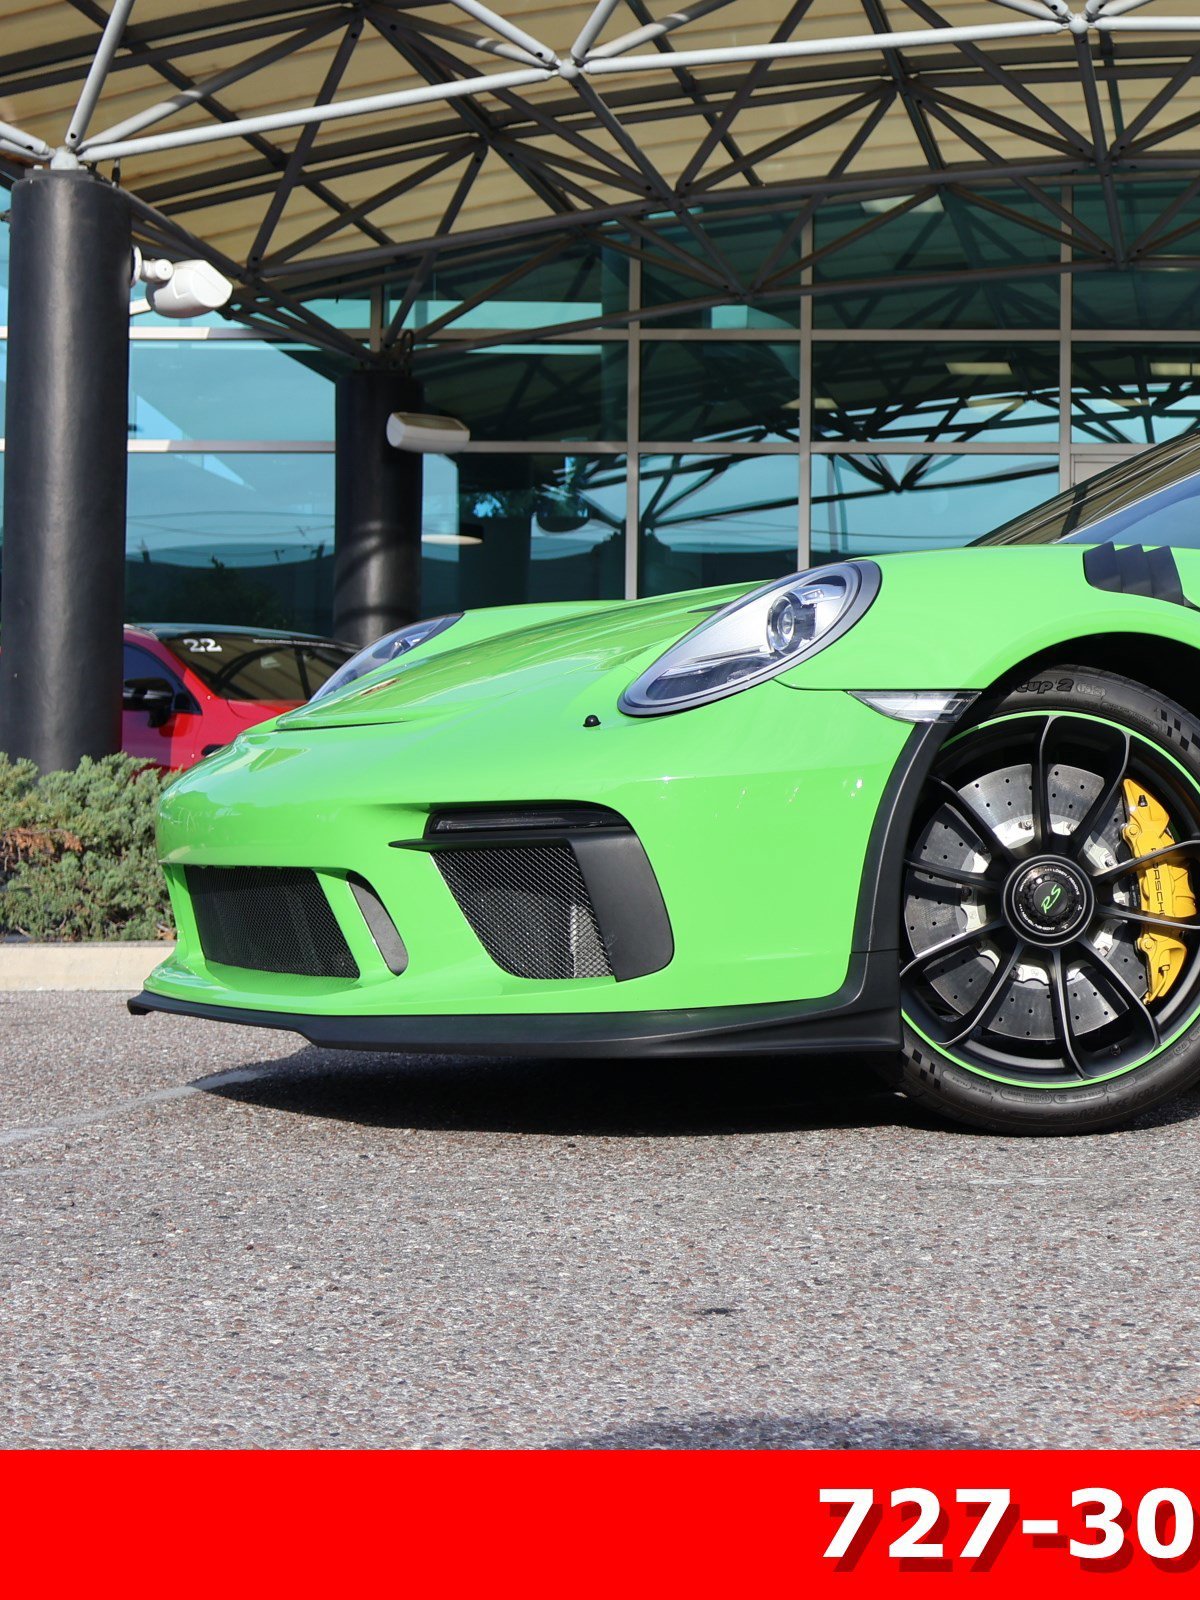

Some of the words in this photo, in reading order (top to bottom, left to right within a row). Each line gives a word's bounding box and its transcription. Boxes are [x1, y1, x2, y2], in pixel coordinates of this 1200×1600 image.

[183, 638, 223, 652] 22
[1057, 678, 1074, 692] 2
[1041, 884, 1061, 914] RS
